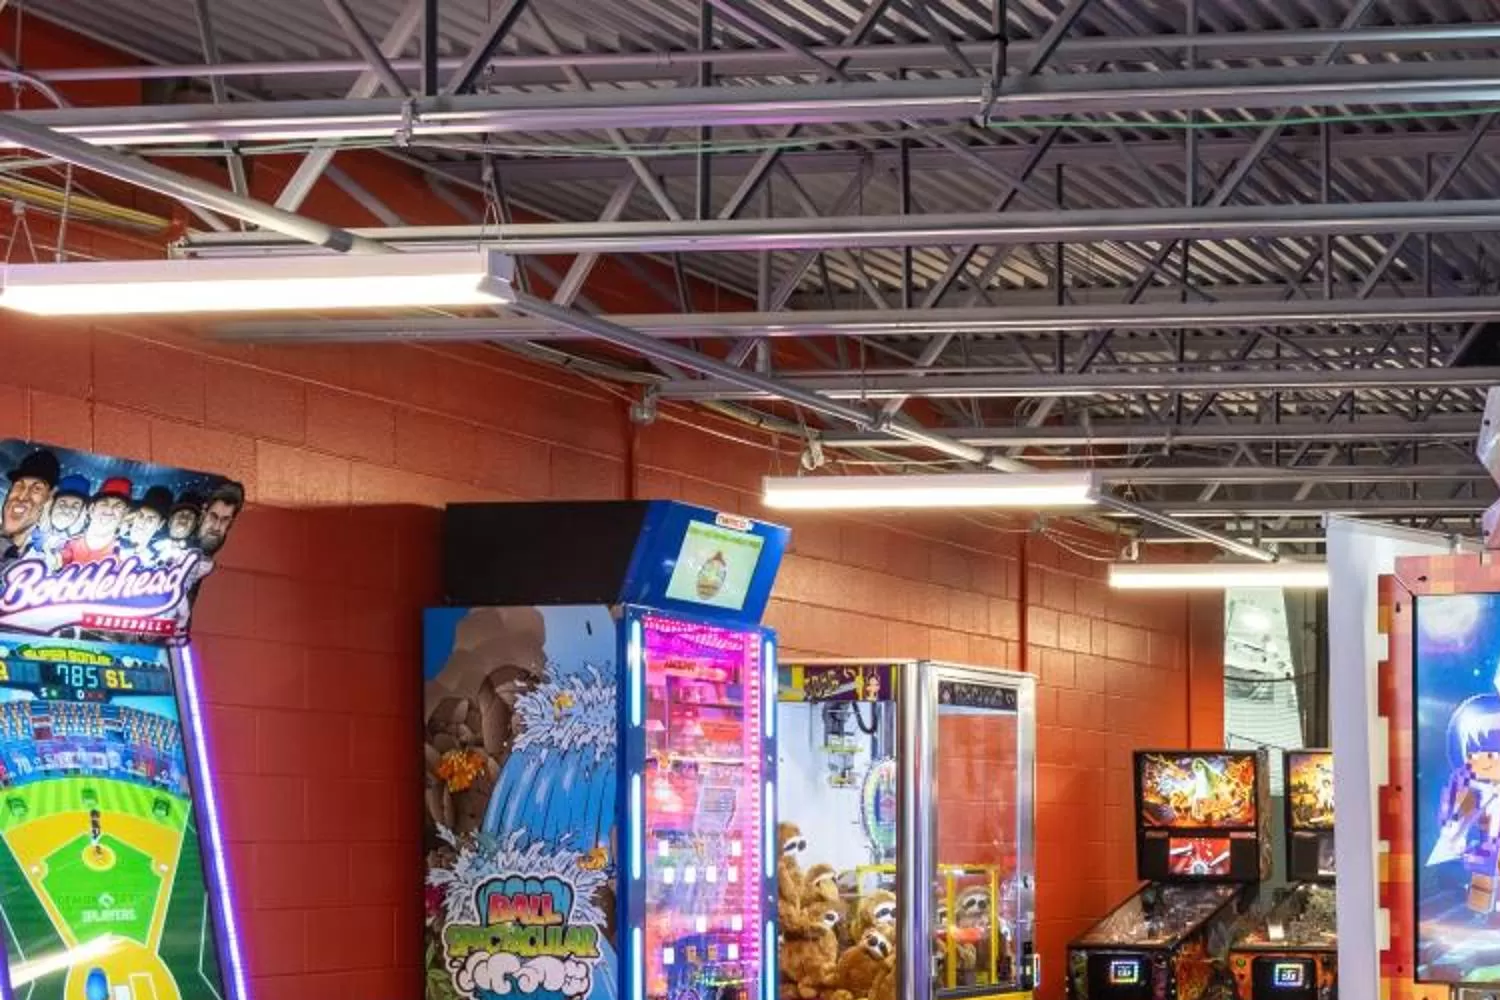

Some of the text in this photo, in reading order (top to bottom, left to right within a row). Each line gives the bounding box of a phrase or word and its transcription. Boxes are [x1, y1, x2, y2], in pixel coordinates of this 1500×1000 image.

[0, 552, 198, 611] Bobblehead
[95, 616, 162, 633] BASEBALL
[105, 669, 133, 689] SL
